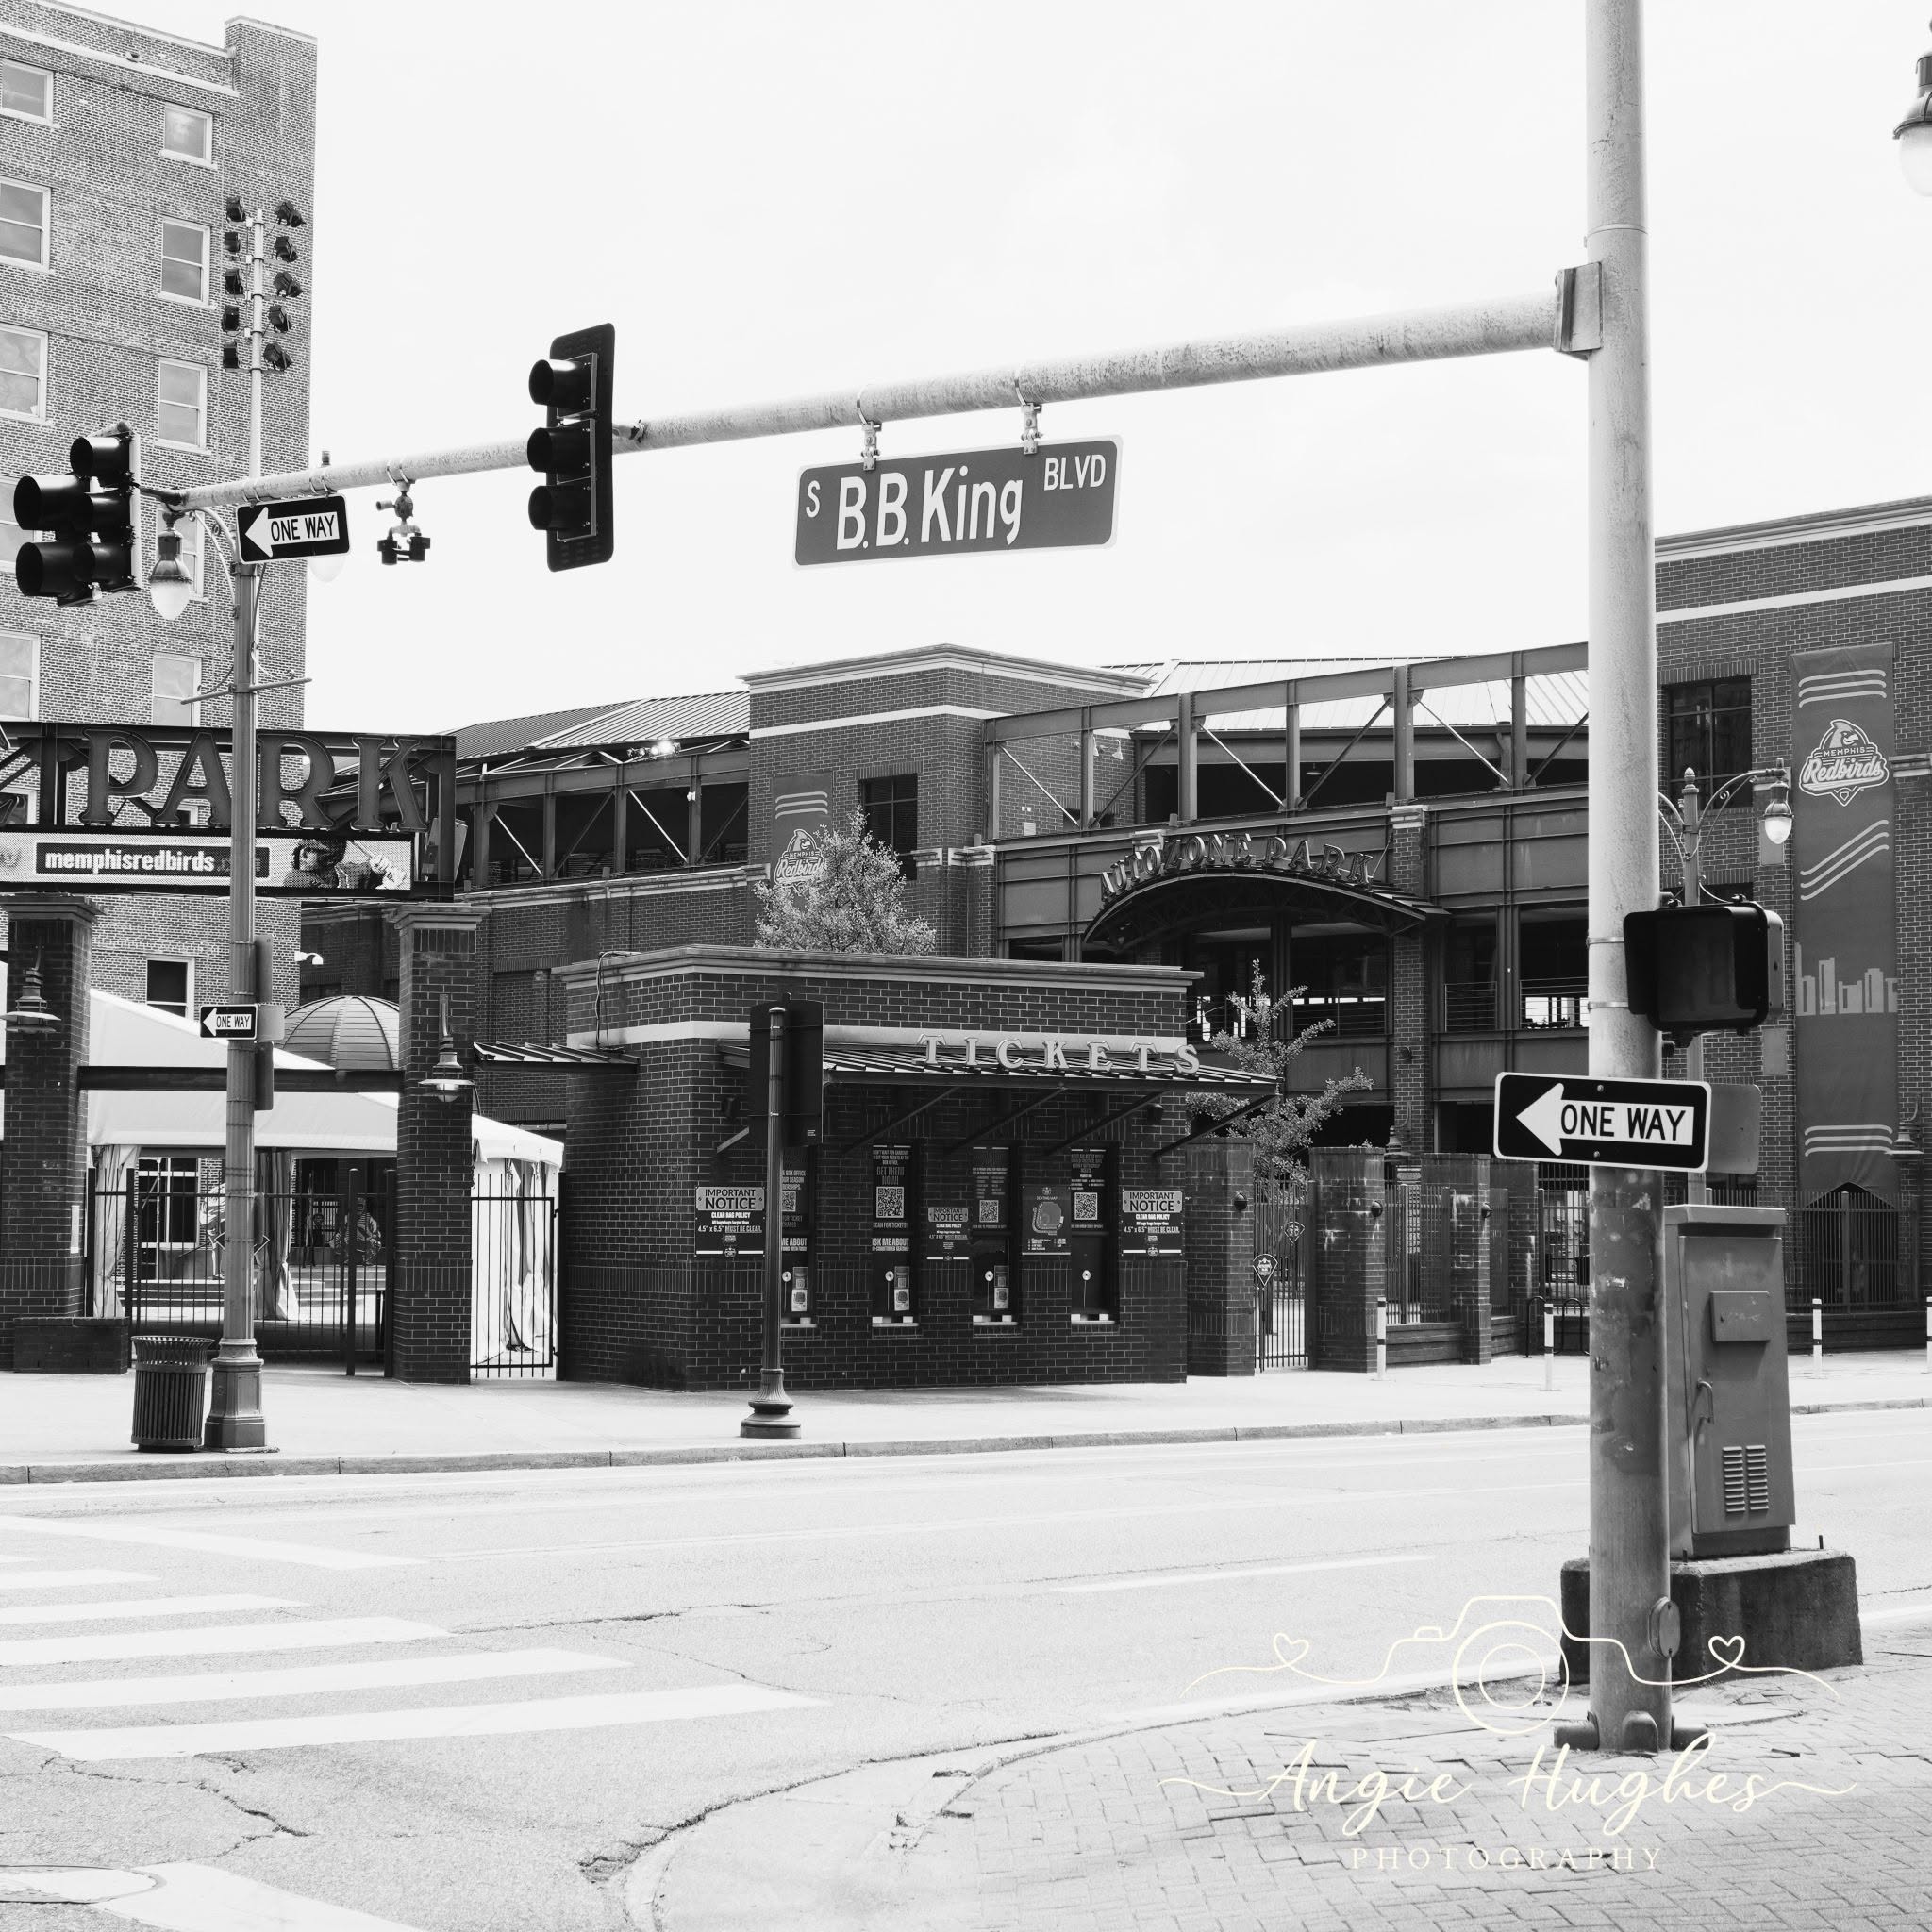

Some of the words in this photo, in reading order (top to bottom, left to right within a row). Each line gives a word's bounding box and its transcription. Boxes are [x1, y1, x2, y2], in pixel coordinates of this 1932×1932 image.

[805, 480, 821, 518] S
[921, 465, 1024, 545] King
[1043, 454, 1107, 491] BLVD
[270, 518, 301, 542] ONE
[304, 514, 335, 539] WAY
[1824, 746, 1866, 757] MEMPHIS
[1803, 756, 1885, 785] Redbirds
[79, 728, 428, 832] PARK
[44, 848, 215, 874] memphisredbirds
[1102, 833, 1257, 896] AUTOZONE
[1261, 836, 1374, 885] PARK
[216, 1015, 232, 1028] ONE
[234, 1015, 251, 1028] WAY
[917, 1033, 1201, 1074] TICKETS
[1560, 1104, 1615, 1138] ONE
[1627, 1107, 1686, 1141] WAY
[705, 1188, 756, 1197] IMPORTANT
[1129, 1191, 1174, 1200] IMPORTANT
[705, 1197, 756, 1210] NOTICE
[1129, 1200, 1174, 1212] NOTICE
[933, 1213, 963, 1222] NOTICE
[790, 1237, 807, 1245] ABOUT
[891, 1237, 909, 1246] ABOUT
